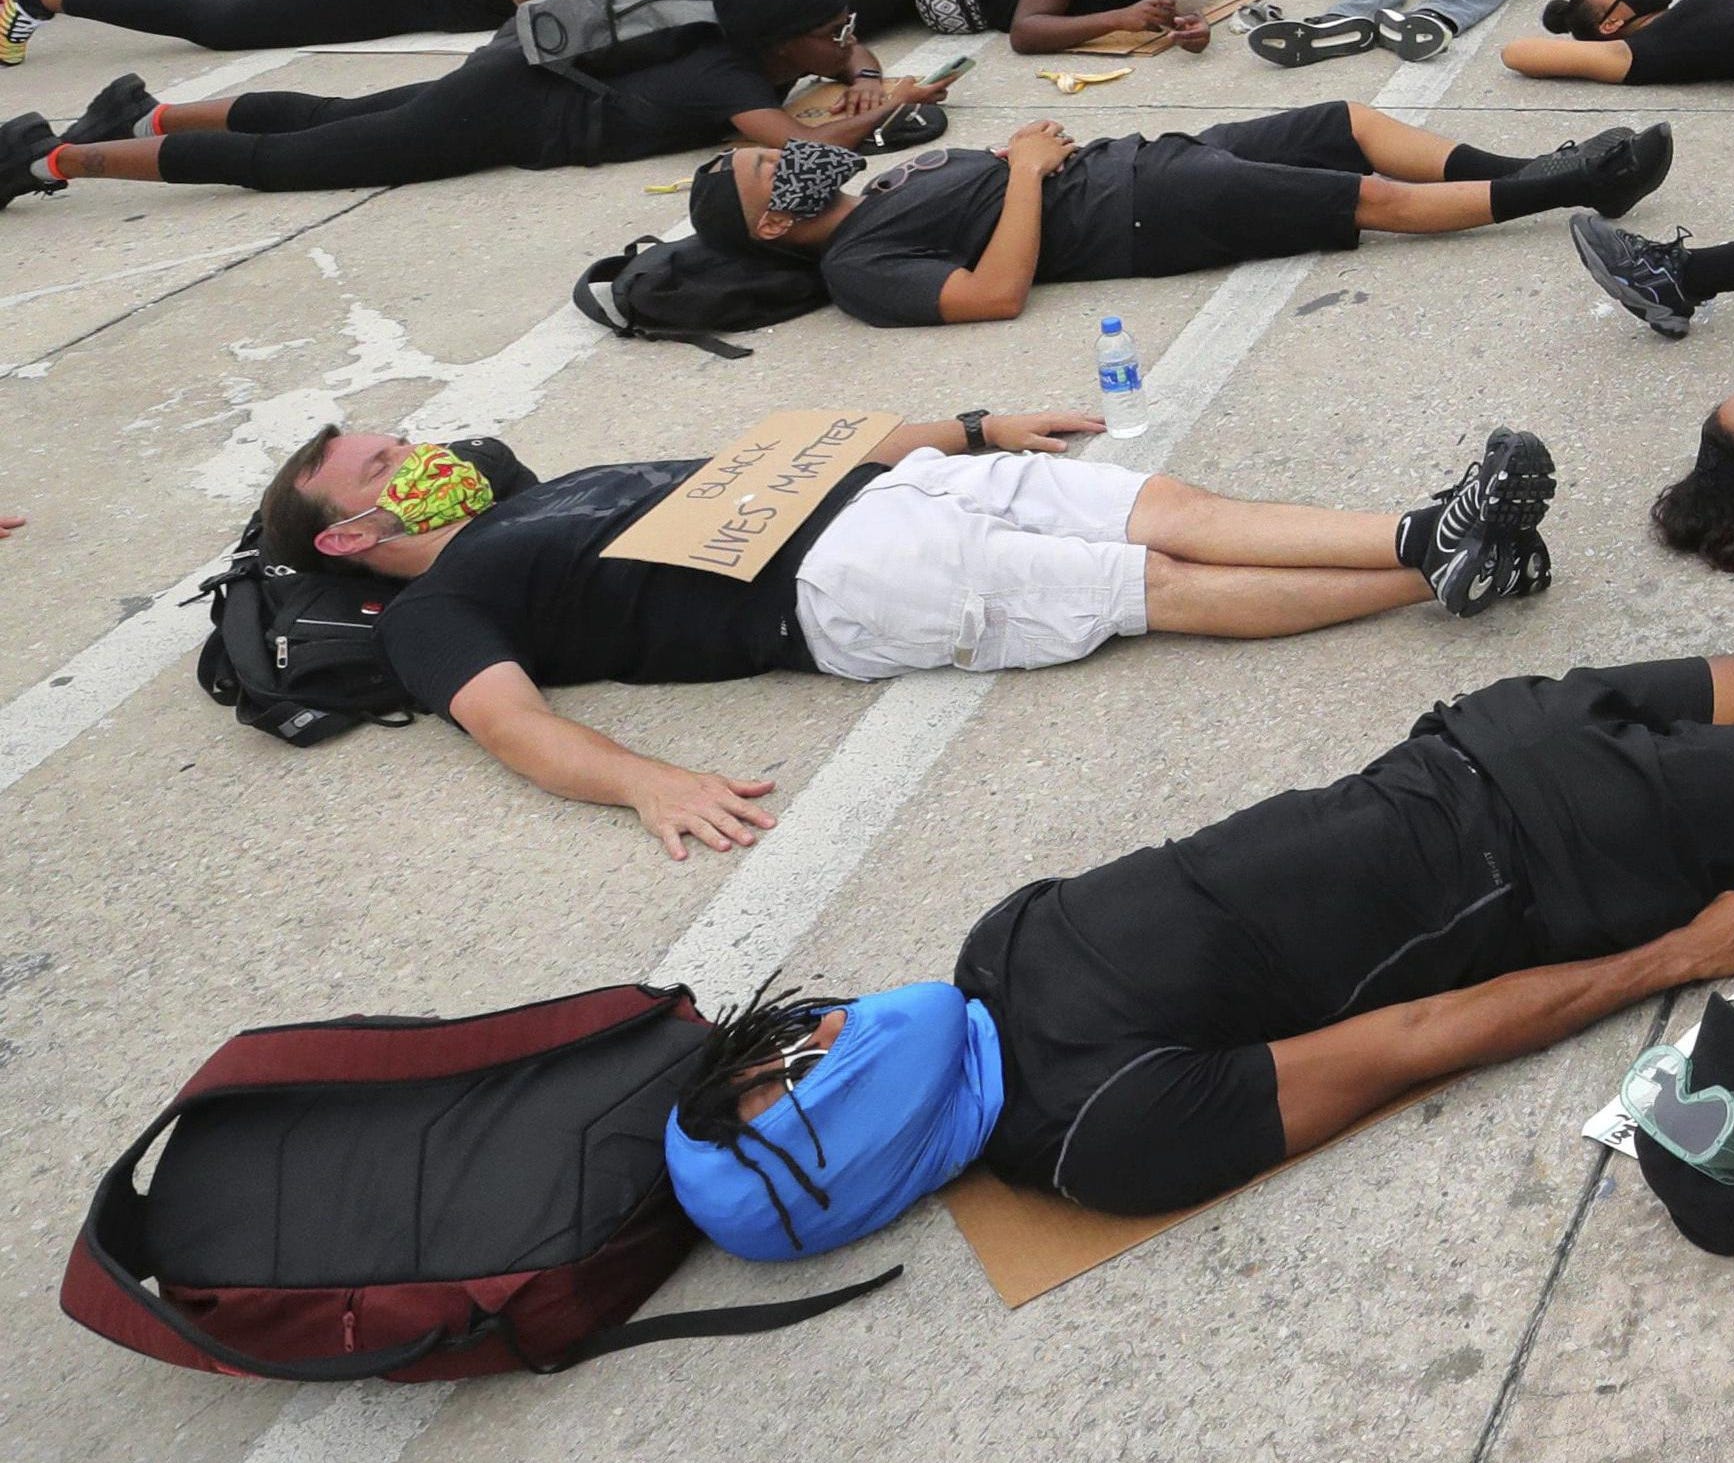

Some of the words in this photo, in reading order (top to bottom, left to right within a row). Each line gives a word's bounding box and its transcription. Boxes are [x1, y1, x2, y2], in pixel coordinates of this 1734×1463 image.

[685, 437, 782, 503] BLACK
[686, 495, 782, 571] LIVES
[770, 413, 869, 517] MATTER
